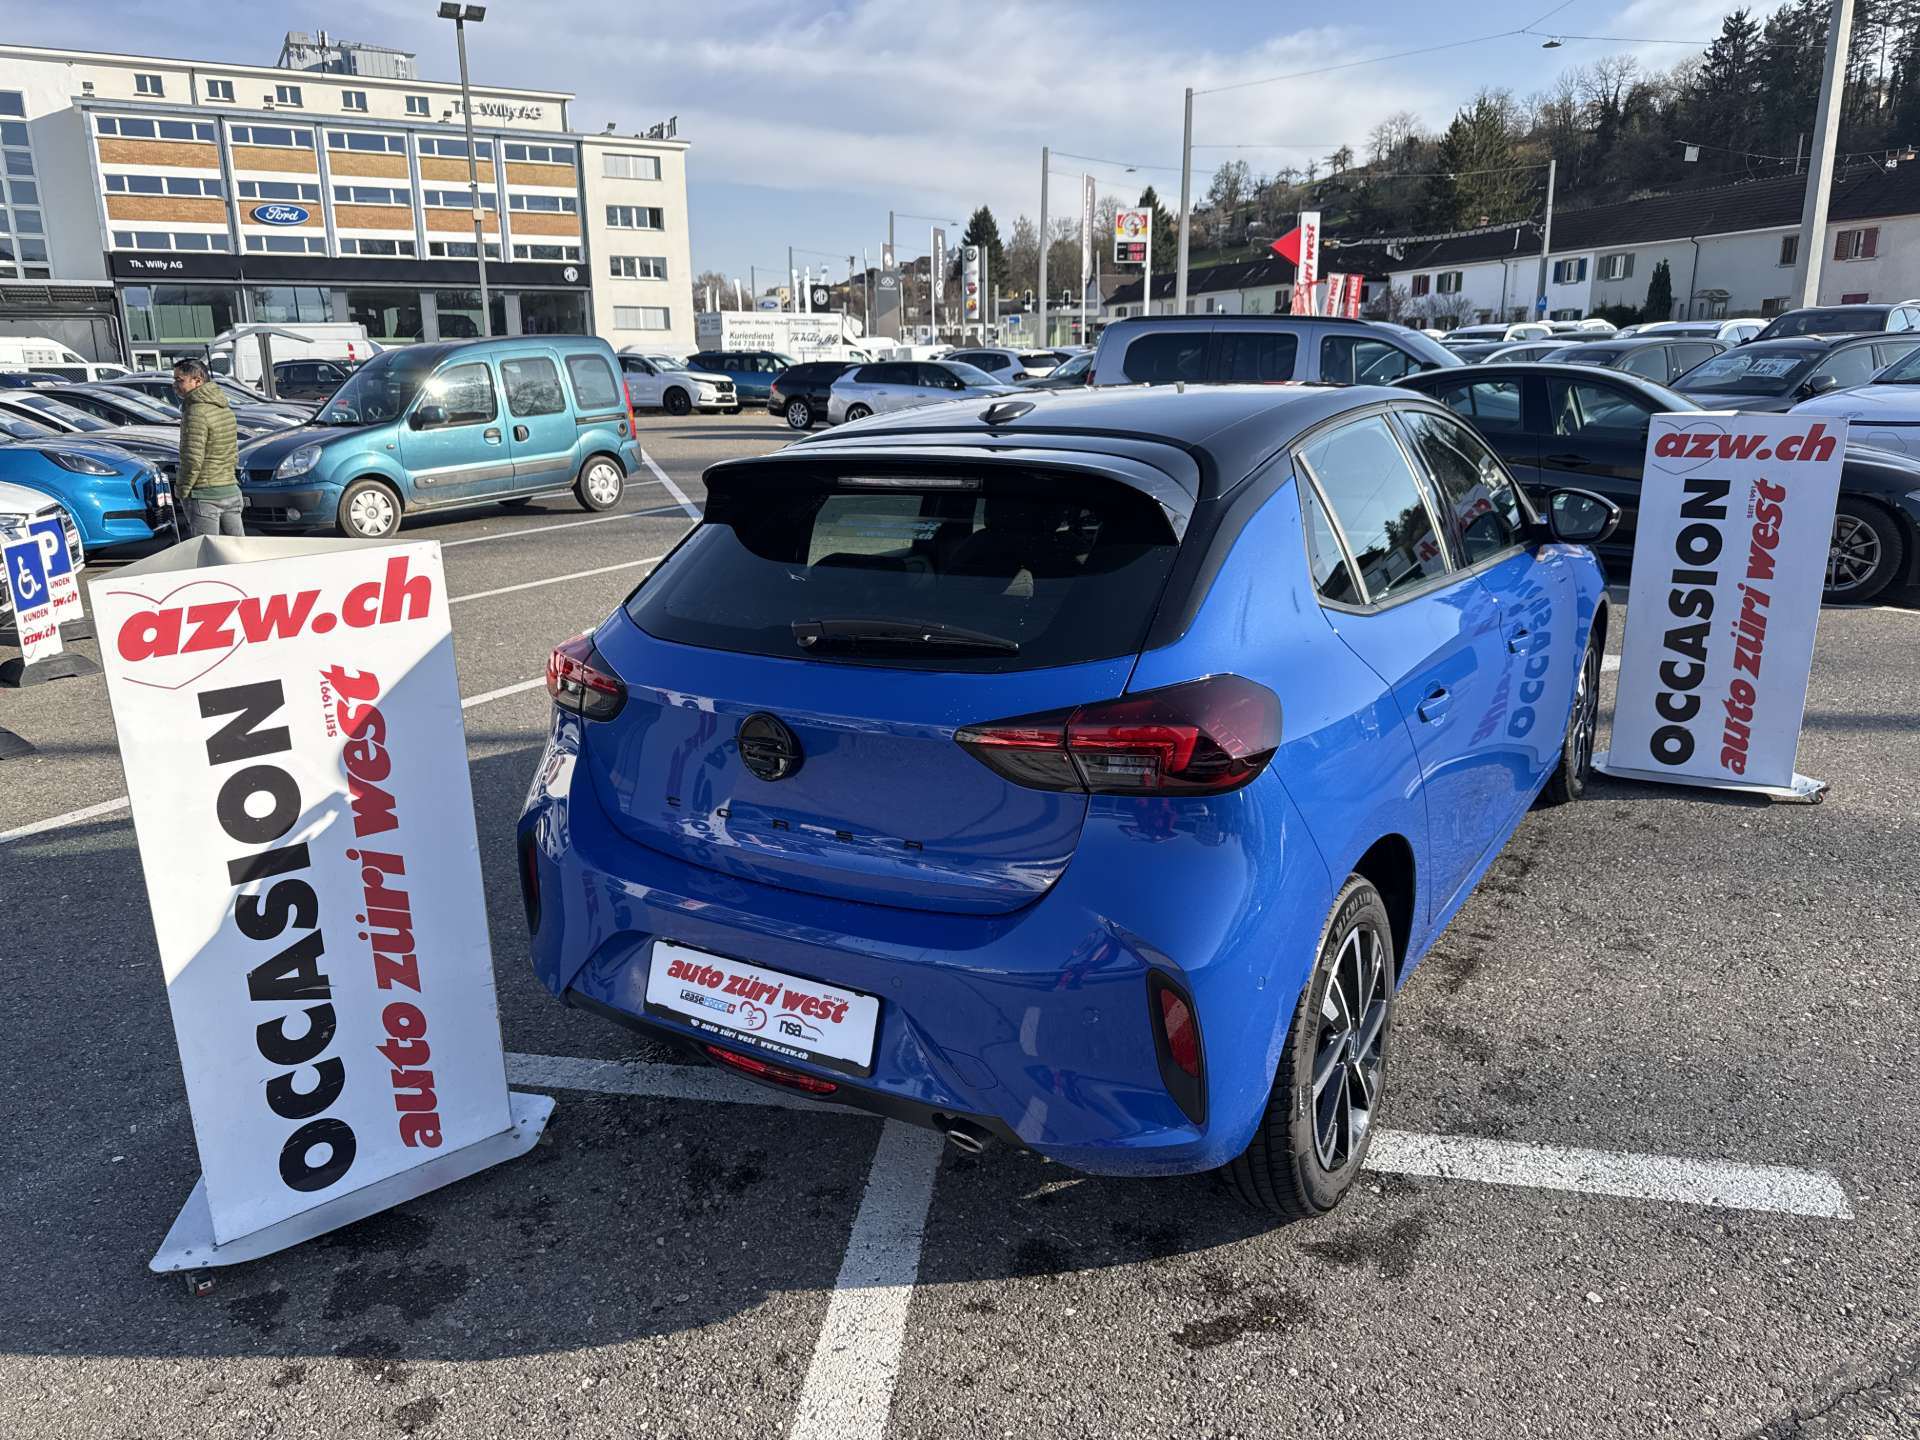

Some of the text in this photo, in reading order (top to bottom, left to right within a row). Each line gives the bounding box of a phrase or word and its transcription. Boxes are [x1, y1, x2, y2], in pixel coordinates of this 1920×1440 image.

[1885, 159, 1898, 168] 48
[266, 206, 298, 221] Ford
[129, 259, 183, 270] Th. Willy AG
[729, 331, 774, 341] Kurierdienst
[1654, 423, 1838, 462] azw.ch
[41, 531, 59, 571] P
[50, 576, 70, 589] UNDEN
[23, 607, 49, 624] KUNDEN
[117, 555, 432, 662] azw.ch
[1650, 478, 1731, 766] OCCASION
[1720, 477, 1787, 775] auto züri west
[23, 623, 56, 646] azw.ch
[319, 680, 337, 738] SEIT 1991
[320, 664, 443, 1149] auto züri west
[196, 678, 357, 1193] OCCASION
[667, 958, 850, 1023] auto züri west
[700, 1022, 809, 1060] auto züri west www.azw.ch
[779, 1020, 802, 1038] nsa
